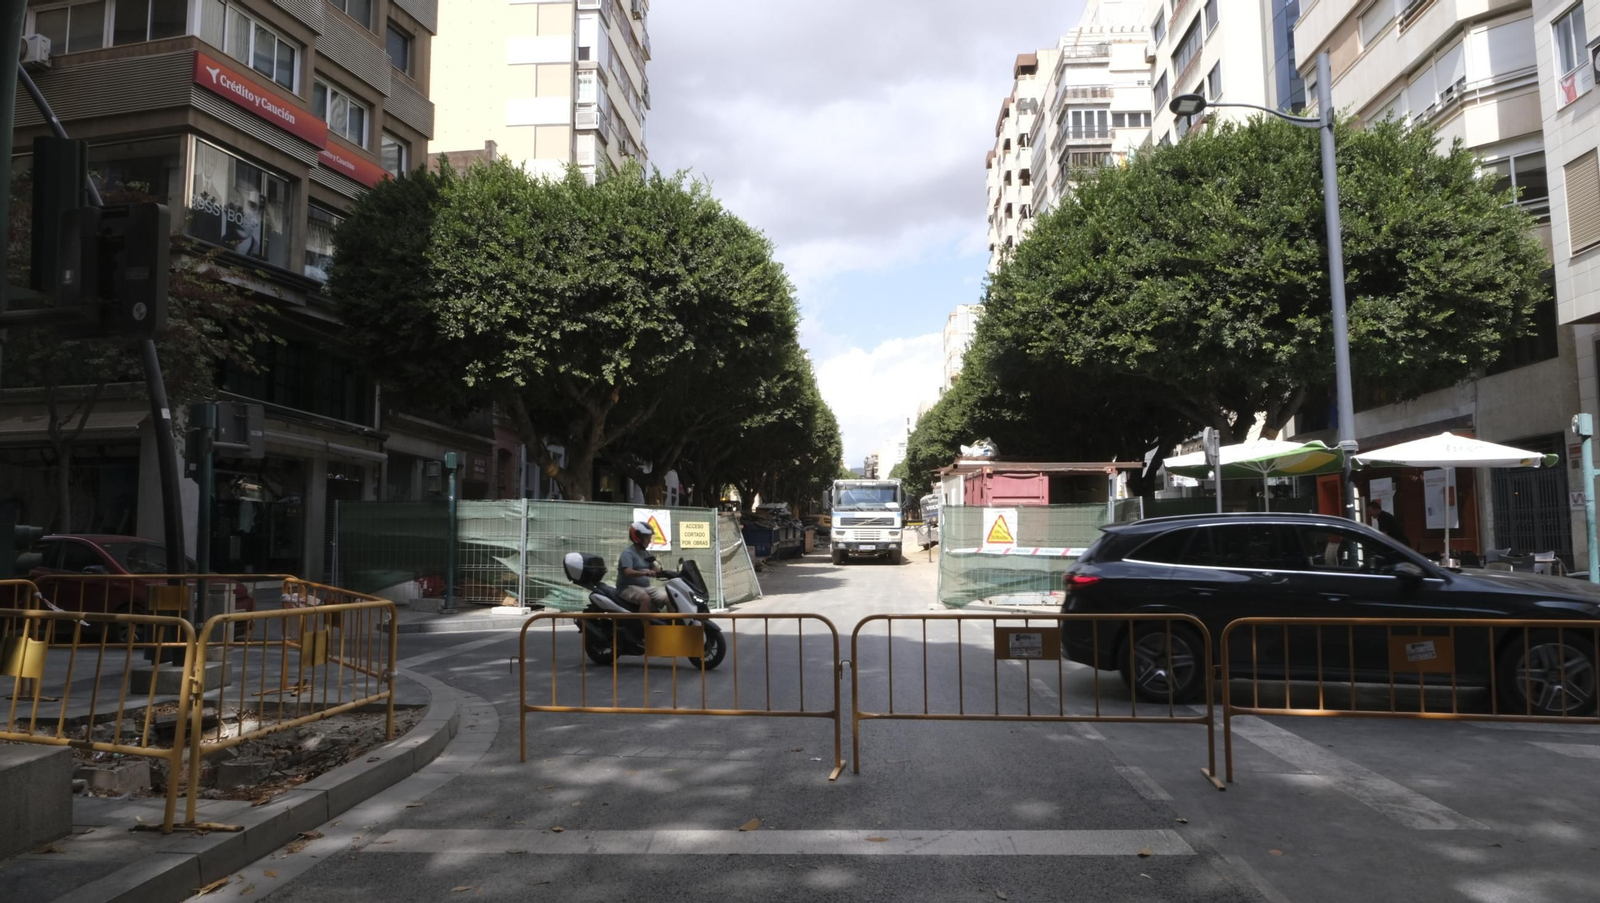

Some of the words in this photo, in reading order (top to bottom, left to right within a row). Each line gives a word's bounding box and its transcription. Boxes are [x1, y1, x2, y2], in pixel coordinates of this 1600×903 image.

[220, 74, 254, 102] Crédito
[254, 95, 261, 107] y
[261, 97, 296, 125] Caución
[336, 155, 355, 171] Caución
[191, 194, 220, 217] BOSS
